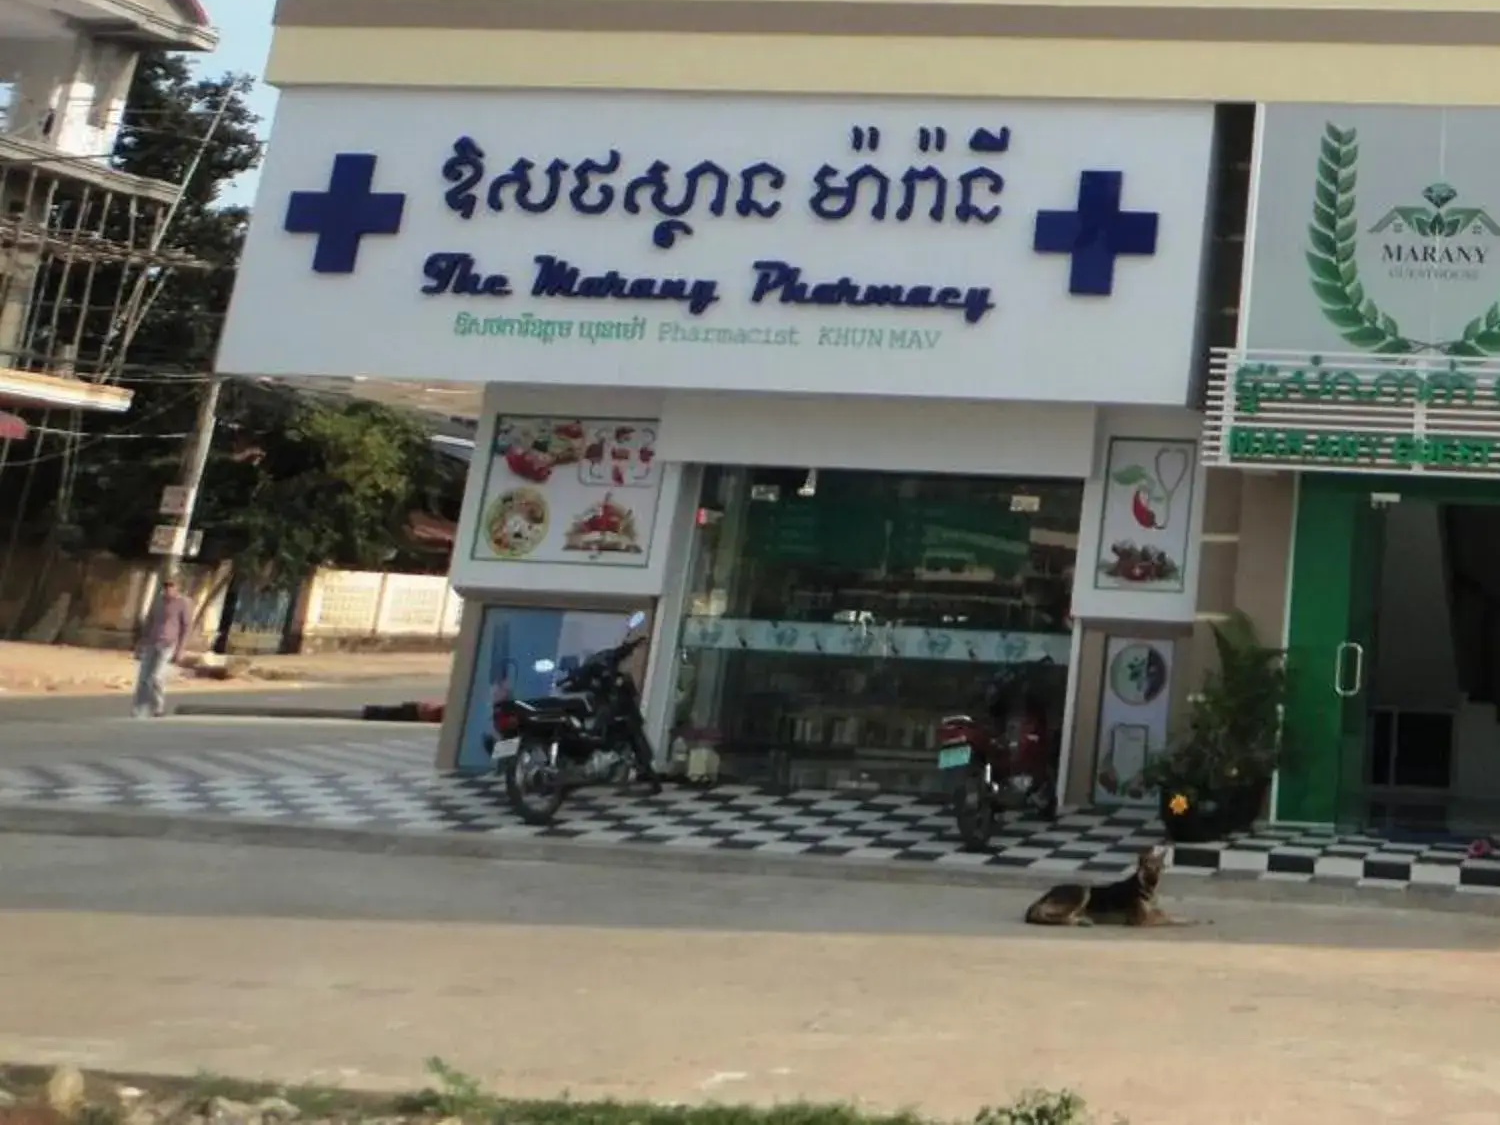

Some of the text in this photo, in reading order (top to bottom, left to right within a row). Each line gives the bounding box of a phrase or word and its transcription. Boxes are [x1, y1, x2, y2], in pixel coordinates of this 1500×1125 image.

[1382, 243, 1489, 265] MARANY
[421, 252, 996, 324] The Marany Pharmacy
[658, 321, 943, 350] Pharmacist KHUN MAV
[1394, 433, 1492, 467] GUEST
